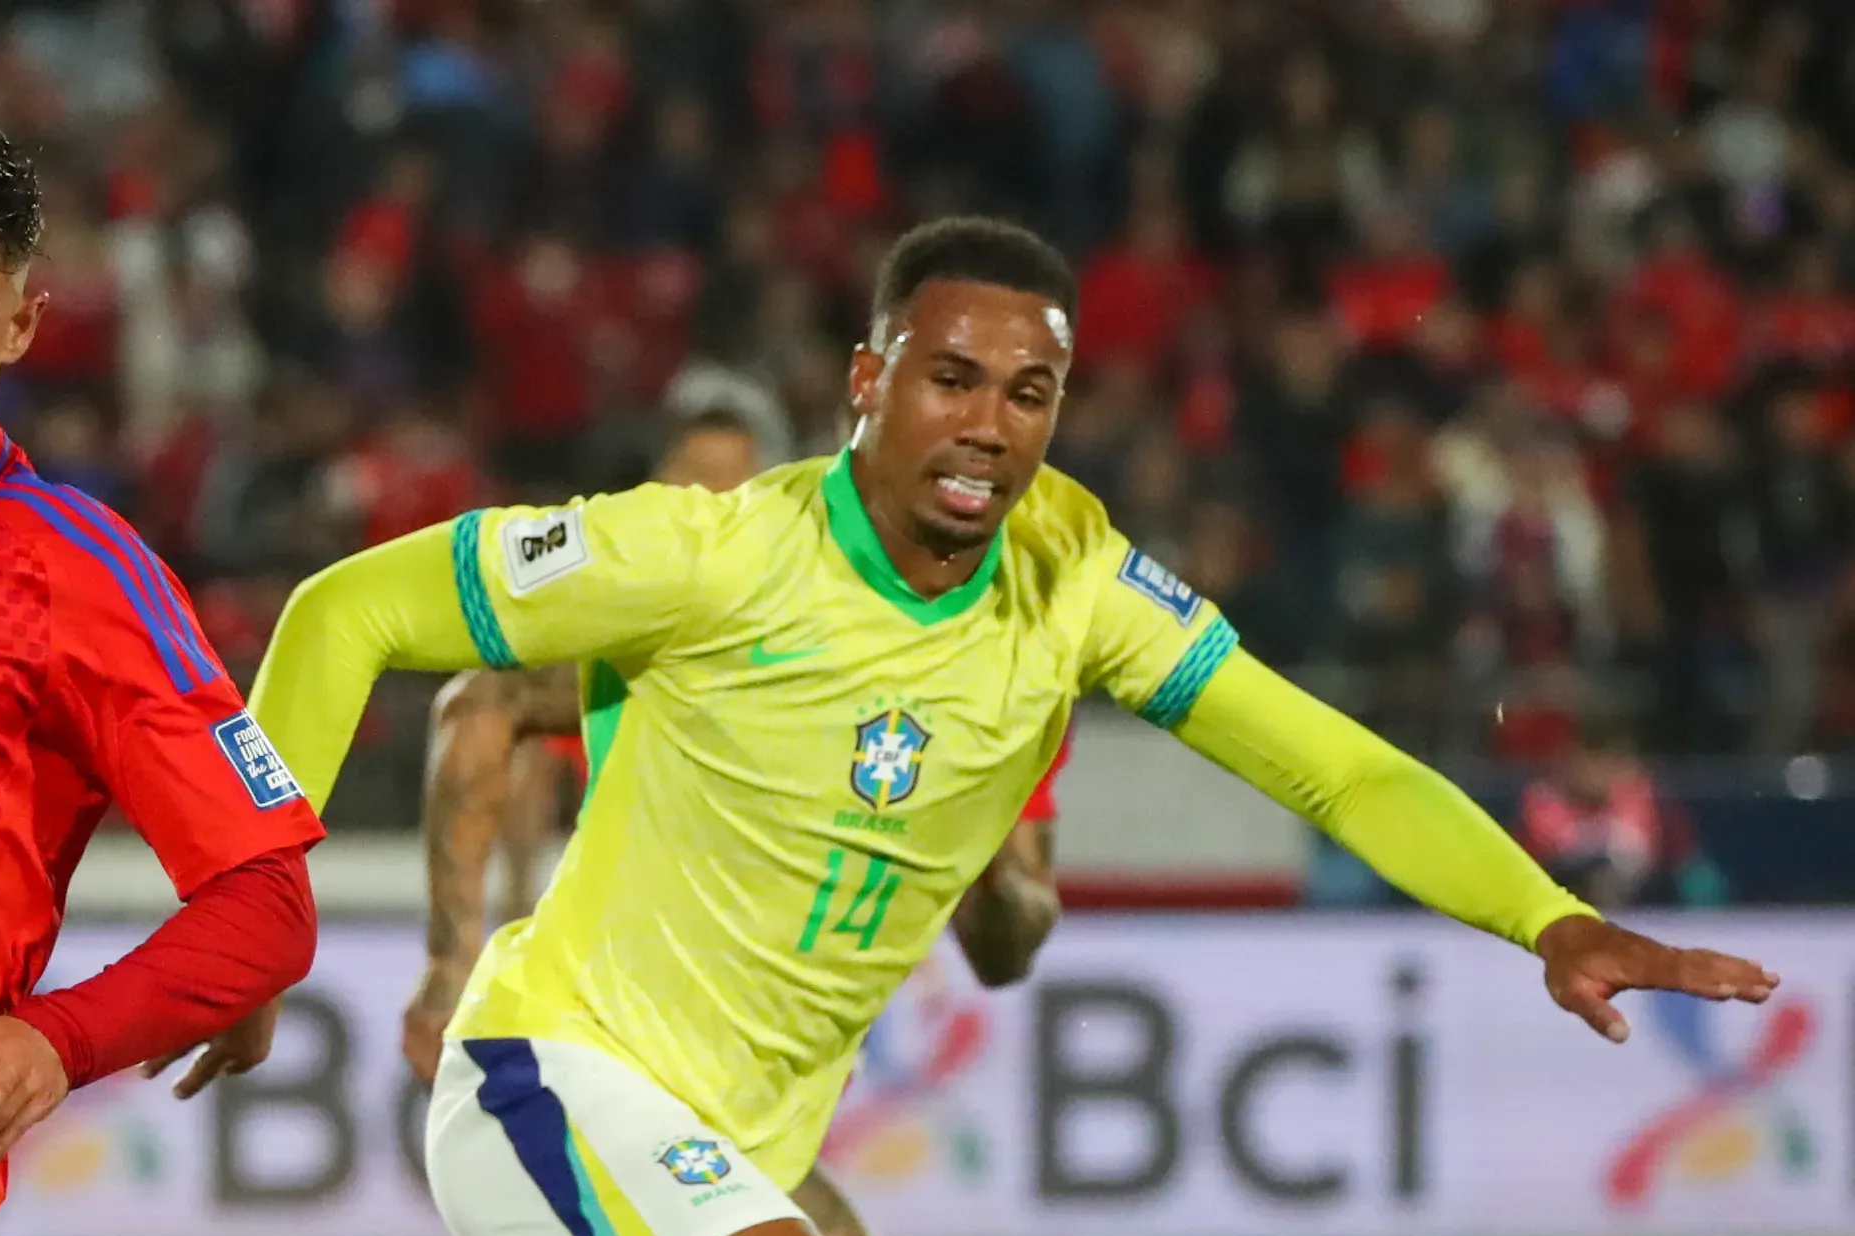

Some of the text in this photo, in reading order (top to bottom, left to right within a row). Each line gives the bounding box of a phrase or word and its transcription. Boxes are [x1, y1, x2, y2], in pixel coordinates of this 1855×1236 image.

[233, 726, 260, 745] FOOT
[240, 738, 269, 763] UNI
[246, 762, 268, 778] the
[798, 849, 902, 952] 14
[1030, 955, 1432, 1208] Bci
